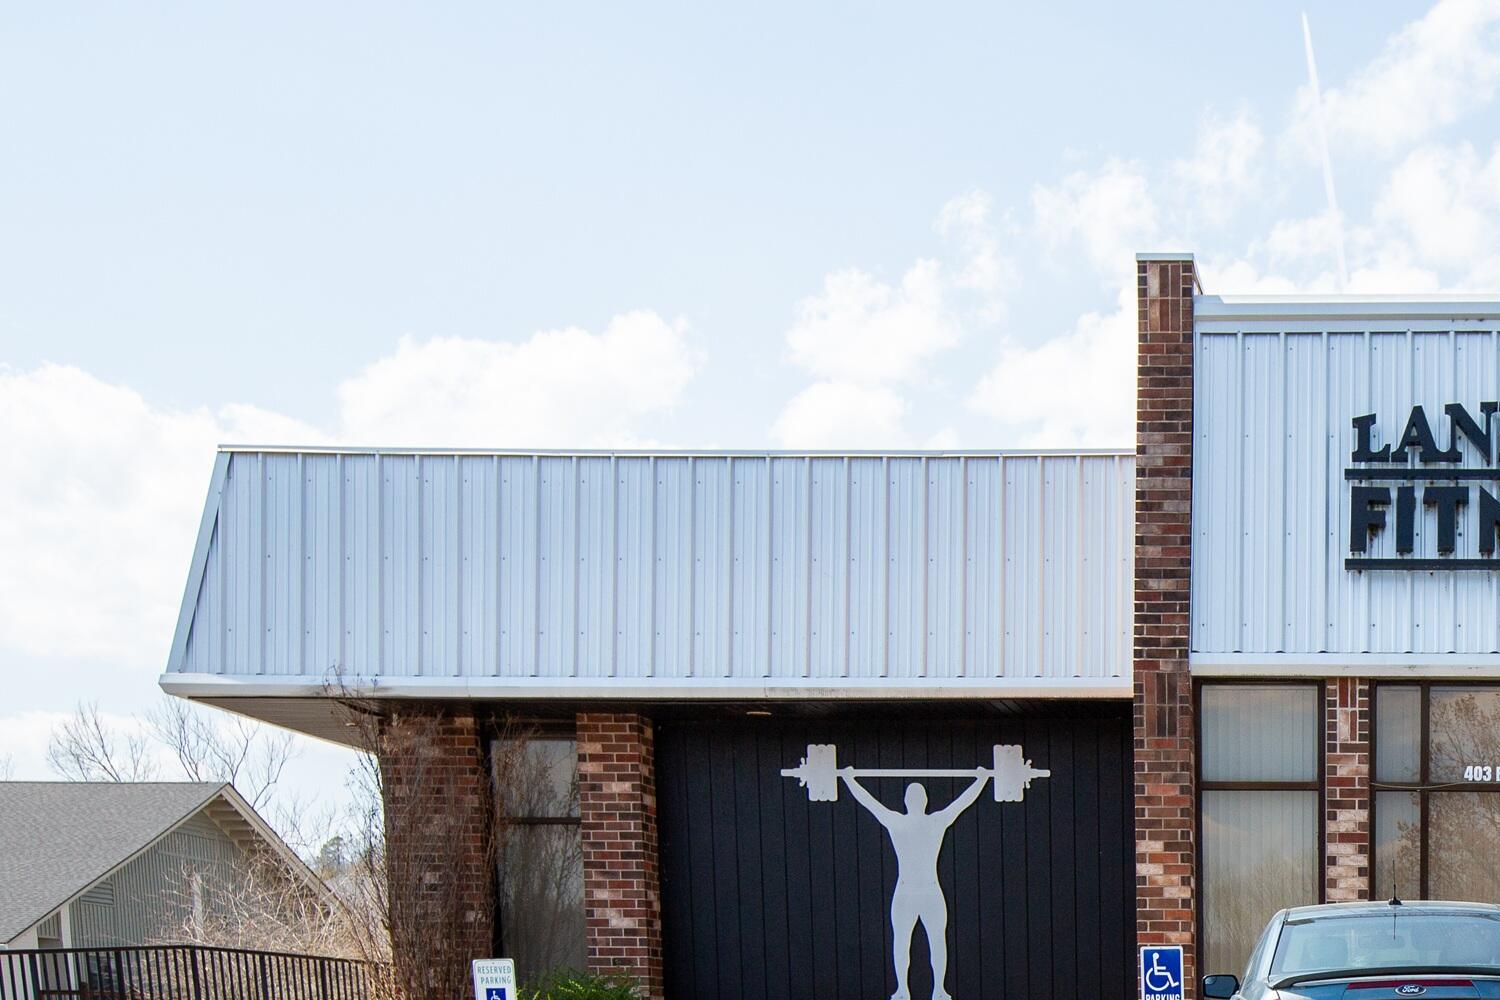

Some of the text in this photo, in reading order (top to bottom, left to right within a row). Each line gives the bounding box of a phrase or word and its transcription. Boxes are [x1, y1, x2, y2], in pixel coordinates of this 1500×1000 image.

[1463, 765, 1492, 782] 403
[477, 965, 512, 974] RESERVED
[480, 975, 512, 985] PARKING
